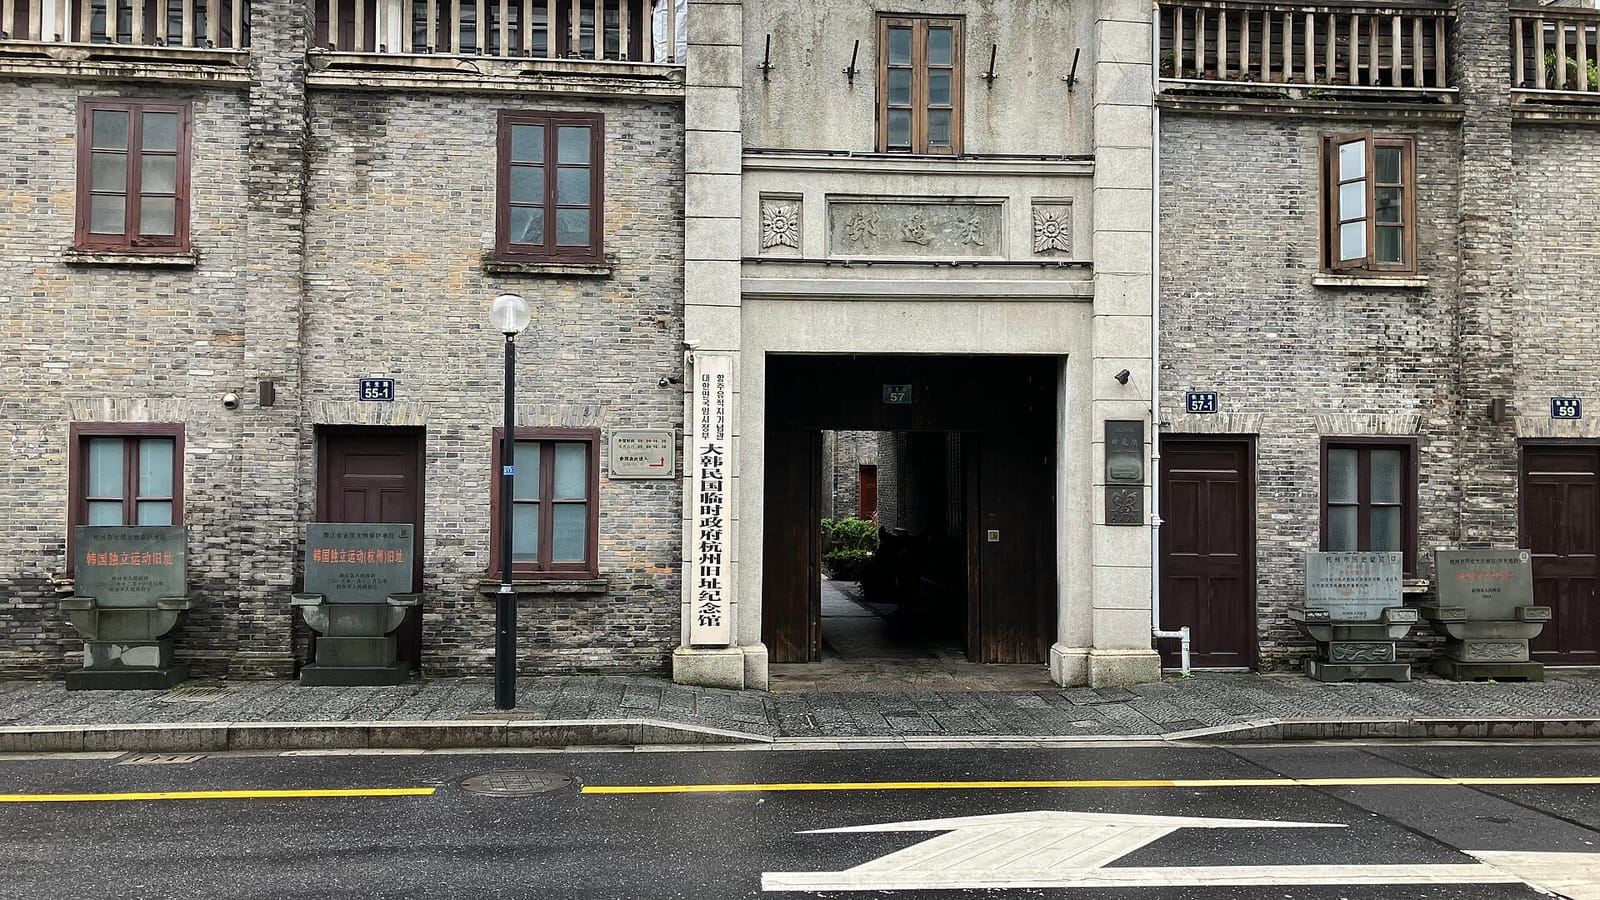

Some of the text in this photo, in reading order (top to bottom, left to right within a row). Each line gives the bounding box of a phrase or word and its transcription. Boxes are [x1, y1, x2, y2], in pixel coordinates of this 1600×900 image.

[365, 388, 389, 398] 55-1
[890, 392, 905, 402] 57
[701, 374, 710, 440] 대한민국임시정부
[716, 374, 725, 440] 항주유적지기념관
[1191, 400, 1213, 411] 57-1
[1559, 406, 1576, 416] 59
[698, 443, 724, 627] 大韩民国临时政府杭州旧址纪念馆
[86, 551, 174, 566] 韩国独立运动旧址
[313, 547, 405, 564] 韩国独立运动(杭州)旧址
